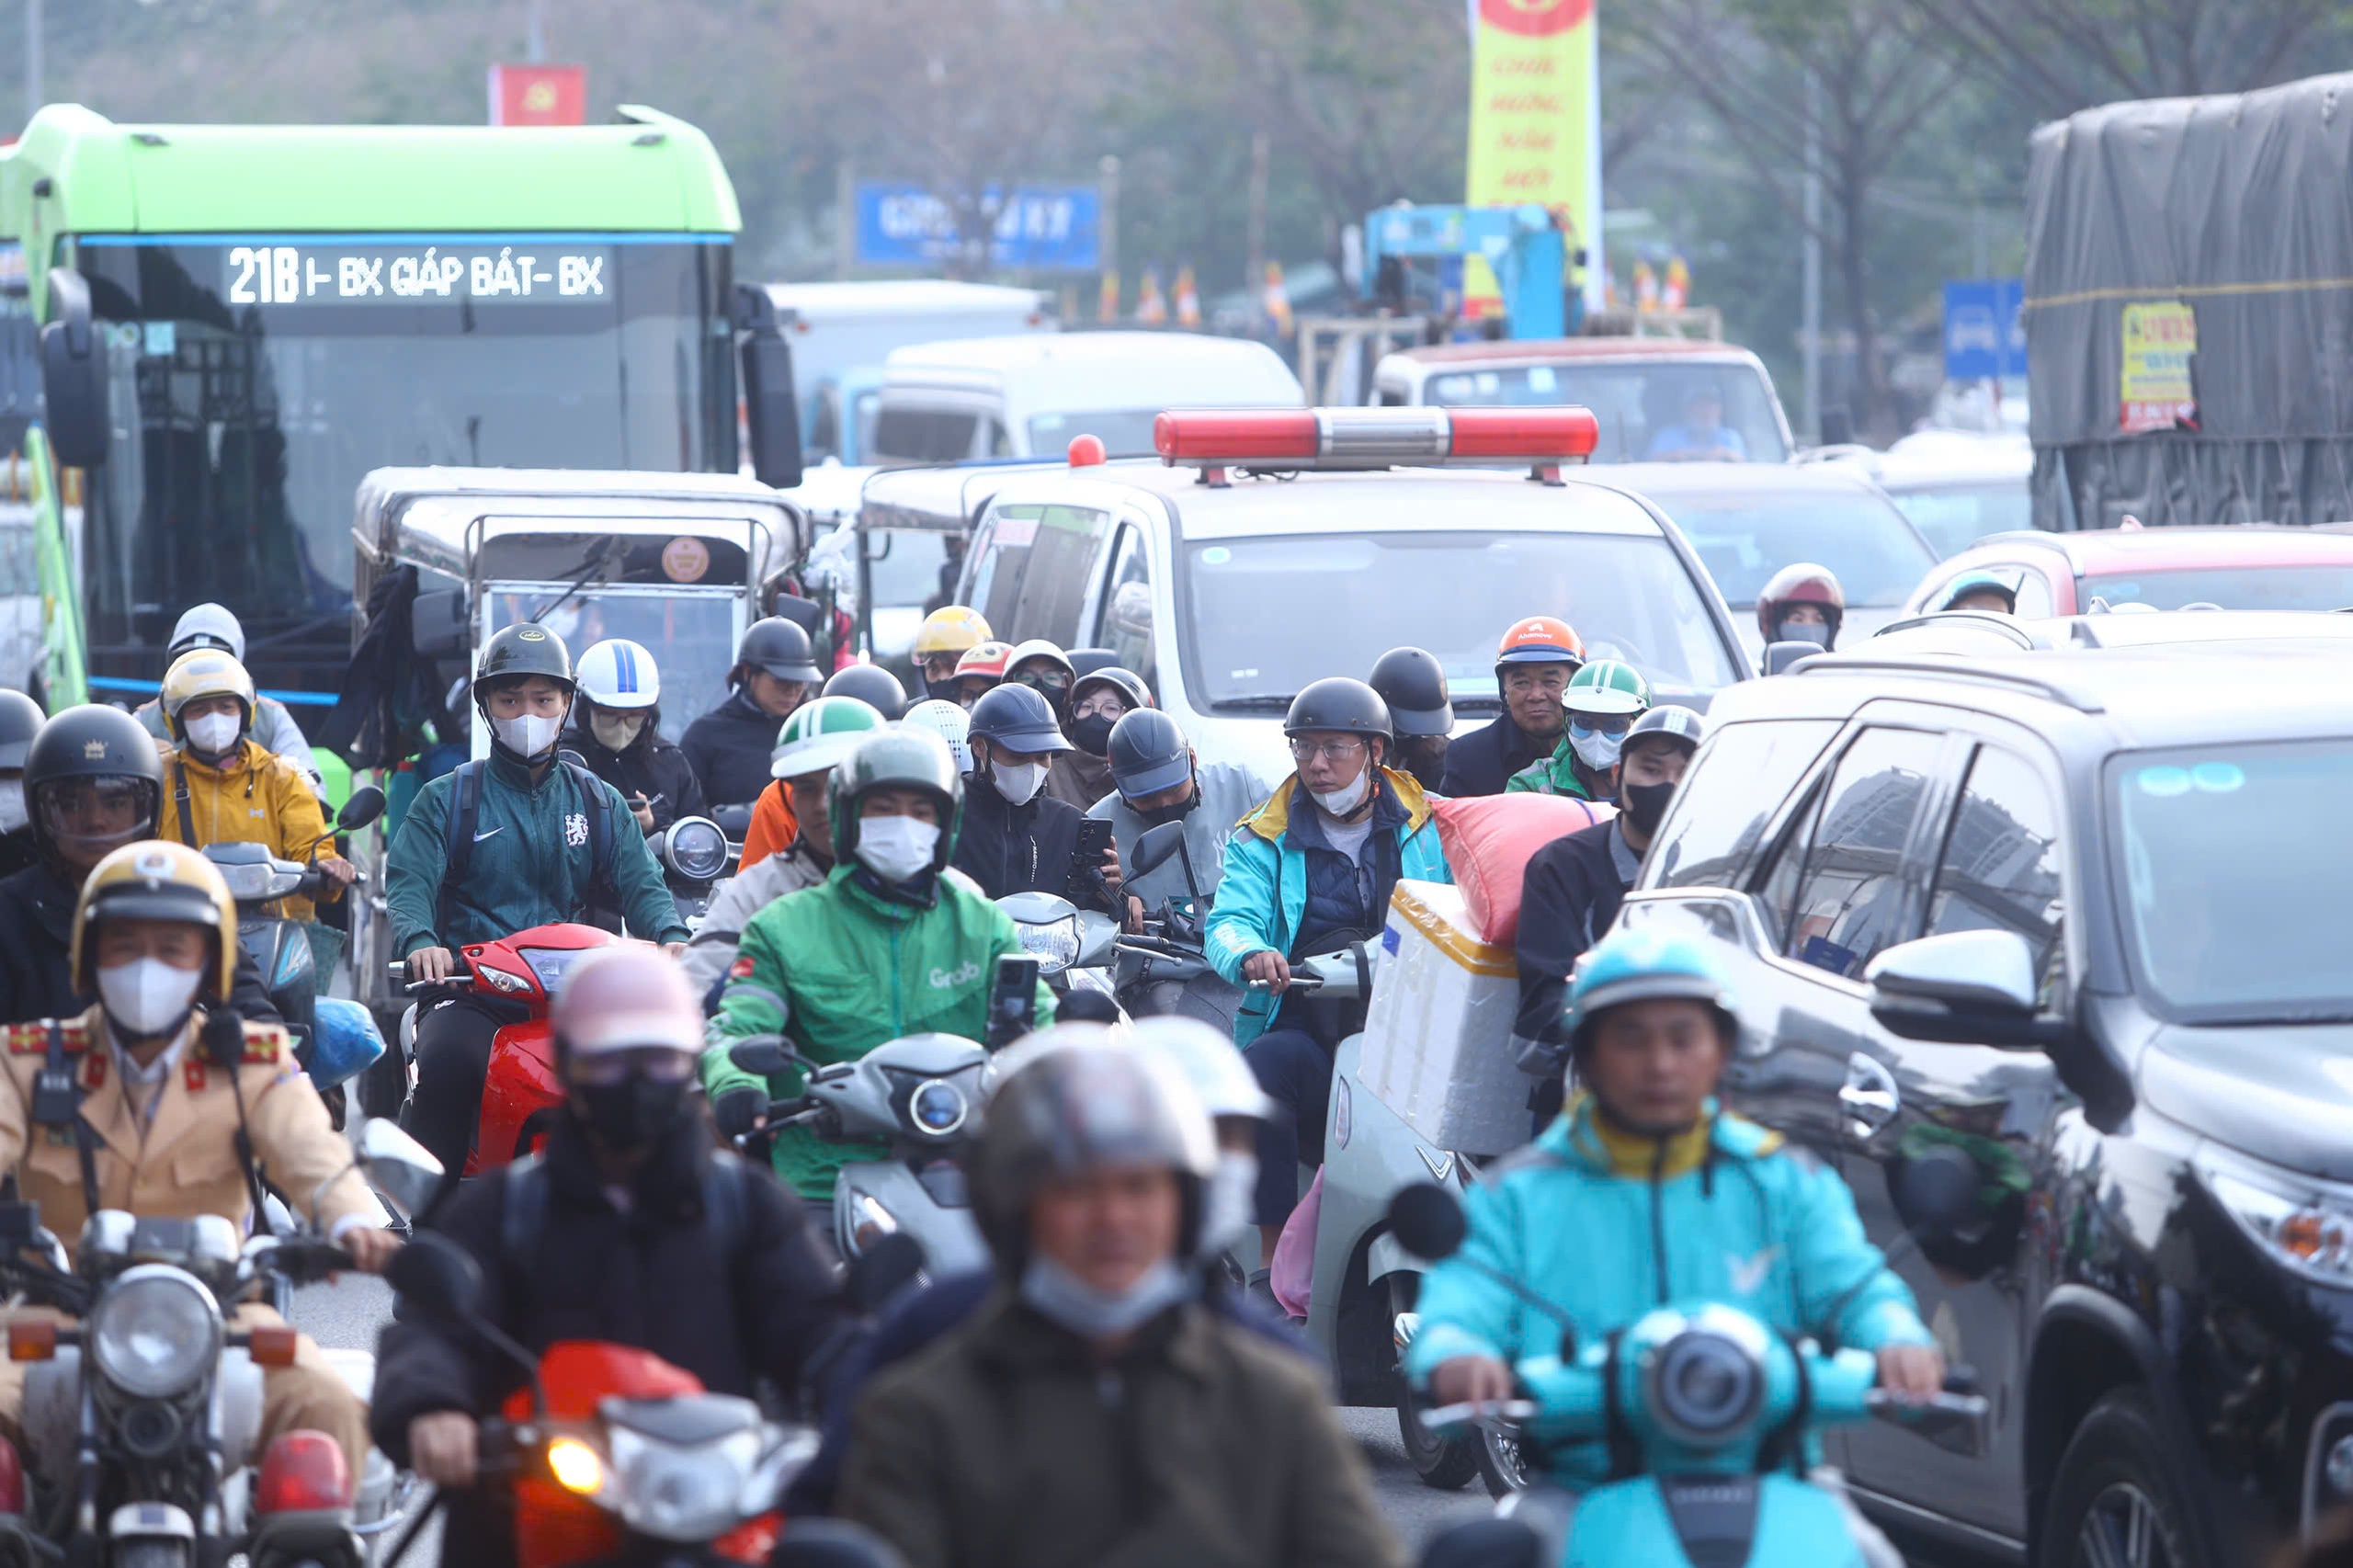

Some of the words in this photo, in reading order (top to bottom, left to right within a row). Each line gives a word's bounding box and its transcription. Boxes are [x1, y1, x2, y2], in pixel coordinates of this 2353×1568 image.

[230, 247, 299, 303] 21B
[339, 257, 383, 296] BX
[391, 246, 464, 296] GIÁP
[559, 256, 603, 295] BX
[929, 960, 981, 988] Grab
